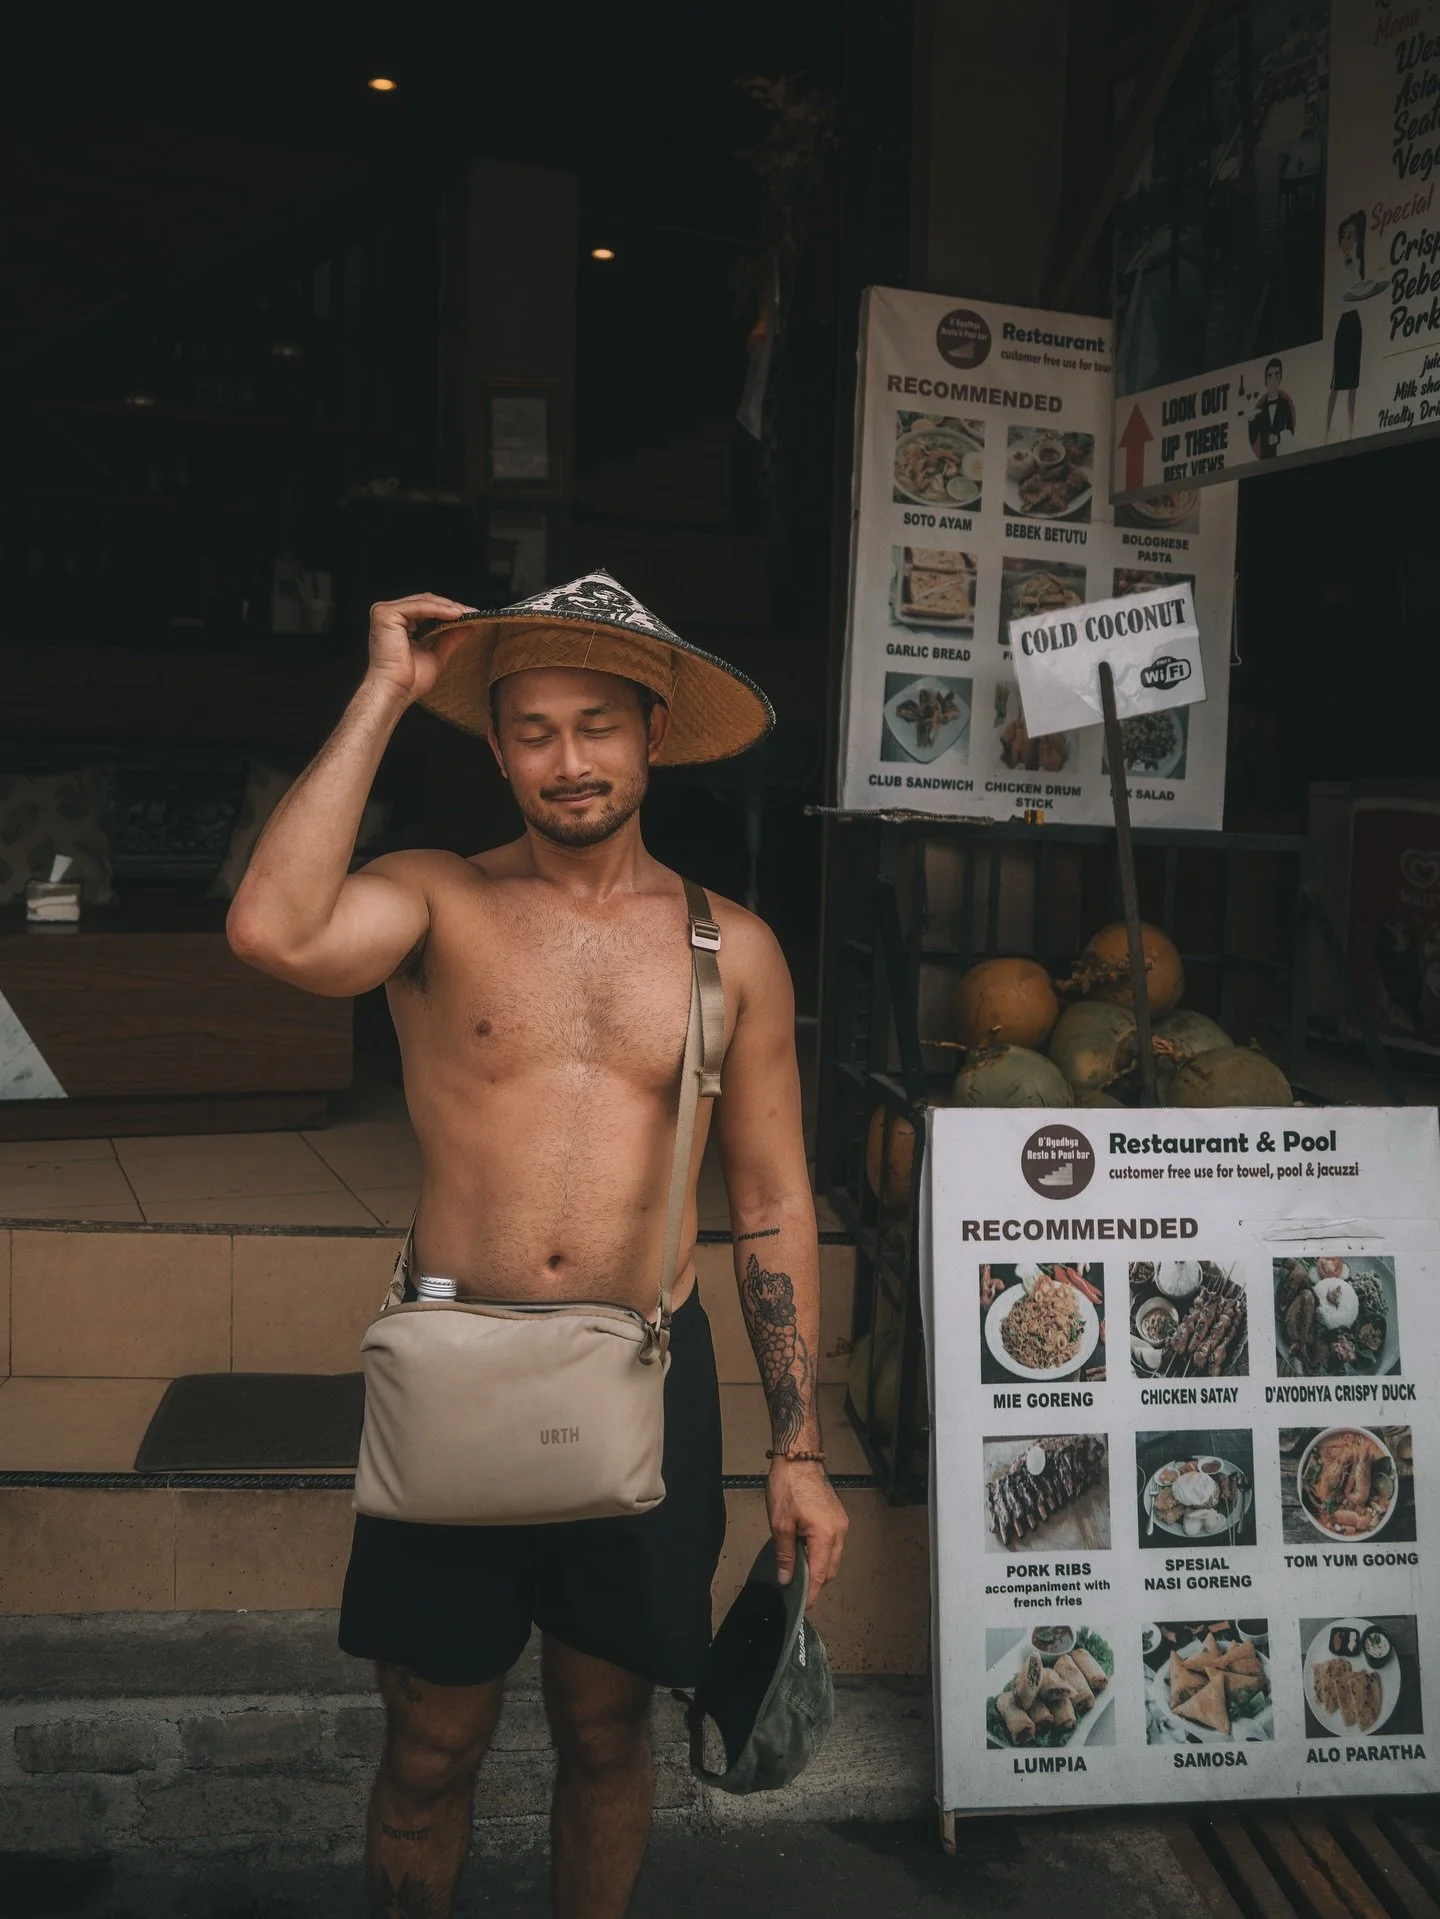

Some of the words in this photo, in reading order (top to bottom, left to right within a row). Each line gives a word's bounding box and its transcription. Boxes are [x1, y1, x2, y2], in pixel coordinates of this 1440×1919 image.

[1373, 8, 1419, 45] Menu
[1393, 70, 1440, 114] Asia
[1393, 97, 1440, 146] Seaf
[1370, 182, 1435, 237] Special
[1391, 262, 1440, 305] Bebe
[1390, 296, 1440, 341] Pork
[1002, 322, 1105, 353] Restaurant
[1000, 350, 1041, 364] customer
[1043, 353, 1060, 368] free
[1062, 359, 1076, 369] use
[1079, 358, 1092, 370] for
[887, 374, 1063, 413] RECOMMENDED
[1393, 379, 1418, 402] Milk
[1161, 393, 1197, 426] LOOK
[1201, 383, 1230, 416] OUT
[1161, 434, 1180, 462] UP
[1184, 422, 1229, 457] THERE
[1164, 462, 1188, 482] BEST
[1191, 454, 1225, 476] VIEWS
[904, 512, 936, 527] SOTO
[938, 516, 972, 531] AYAM
[1005, 522, 1042, 541] BEBEK
[1044, 527, 1087, 545] BETUTU
[1122, 534, 1189, 550] BOLOGNESE
[1138, 551, 1172, 564] PASTA
[1021, 622, 1078, 656] COLD
[1085, 598, 1186, 642] COCONUT
[886, 643, 930, 658] GARLIC
[932, 647, 971, 662] BREAD
[868, 774, 902, 787] CLUB
[906, 777, 974, 792] SANDWICH
[985, 782, 1042, 795] CHICKEN
[1046, 784, 1082, 797] DRUM
[1016, 798, 1053, 809] STICK
[1136, 788, 1175, 801] SALAD
[1109, 1132, 1249, 1154] Restaurant
[1256, 1131, 1276, 1152] &
[1283, 1130, 1337, 1152] Pool
[1027, 1150, 1049, 1160] Resto
[1058, 1150, 1074, 1160] Pool
[1076, 1150, 1090, 1160] bar
[1109, 1165, 1164, 1180] customer
[1168, 1164, 1191, 1179] free
[1194, 1166, 1214, 1179] use
[1216, 1164, 1234, 1178] for
[1236, 1163, 1274, 1180] towel,
[1277, 1162, 1302, 1180] pool
[1306, 1162, 1315, 1176] &
[1317, 1162, 1360, 1179] jacuzzi
[962, 1217, 1199, 1242] RECOMMENDED
[993, 1393, 1022, 1409] MIE
[1026, 1392, 1094, 1408] GORENG
[1141, 1389, 1197, 1405] CHICKEN
[1200, 1388, 1239, 1404] SATAY
[1265, 1386, 1332, 1403] D'AYODHYA
[1334, 1384, 1379, 1402] CRISPY
[1382, 1384, 1416, 1401] DUCK
[540, 1426, 580, 1445] URTH
[1165, 1557, 1229, 1572] SPESIAL
[1284, 1555, 1317, 1568] TOM
[1321, 1554, 1358, 1568] YUM
[1362, 1552, 1418, 1566] GOONG
[1006, 1564, 1050, 1578] PORK
[1054, 1562, 1092, 1576] RIBS
[985, 1581, 1081, 1594] accompaniment
[1084, 1579, 1111, 1592] with
[1144, 1576, 1182, 1591] NASI
[1186, 1574, 1252, 1590] GORENG
[1014, 1596, 1052, 1608] french
[1055, 1595, 1083, 1607] fries
[1173, 1750, 1248, 1768] SAMOSA
[1306, 1747, 1341, 1764] ALO
[1346, 1744, 1426, 1762] PARATHA
[1013, 1755, 1087, 1774] LUMPIA
